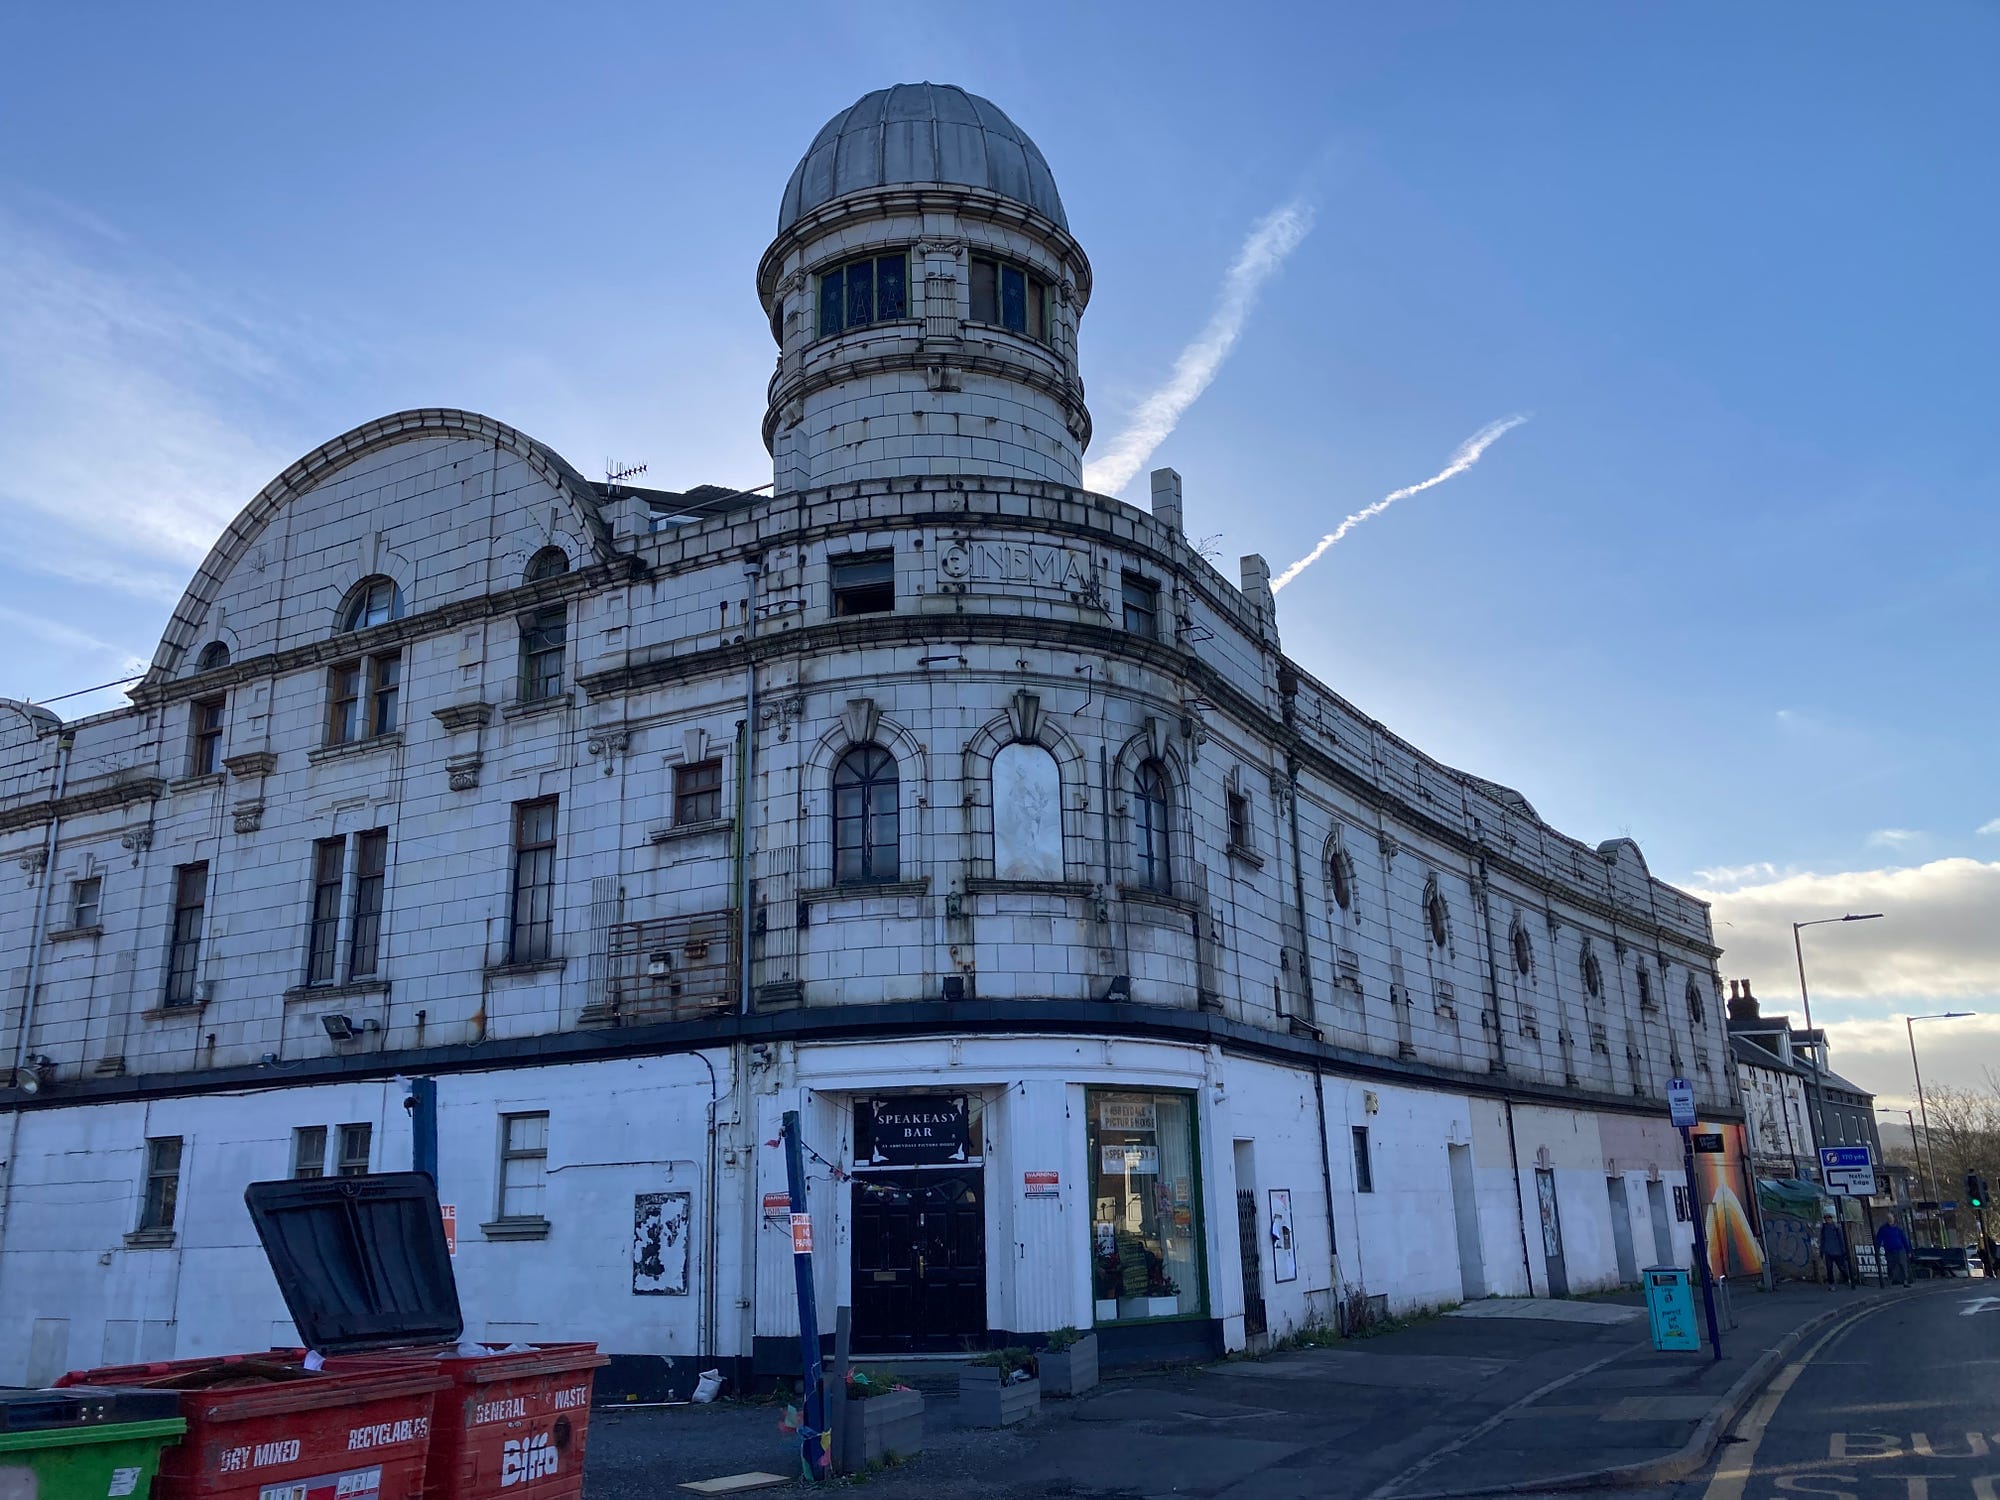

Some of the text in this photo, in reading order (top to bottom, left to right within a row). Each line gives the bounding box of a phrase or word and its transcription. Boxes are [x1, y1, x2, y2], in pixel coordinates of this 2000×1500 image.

[942, 543, 1089, 590] CINEMA
[878, 1112, 958, 1125] SPEAKEASY
[904, 1127, 933, 1138] BAR
[475, 1384, 588, 1424] GENERAL WASTE
[348, 1417, 429, 1450] RECYCLABLES
[220, 1439, 301, 1472] DRY MIXED
[501, 1432, 559, 1488] Biffa
